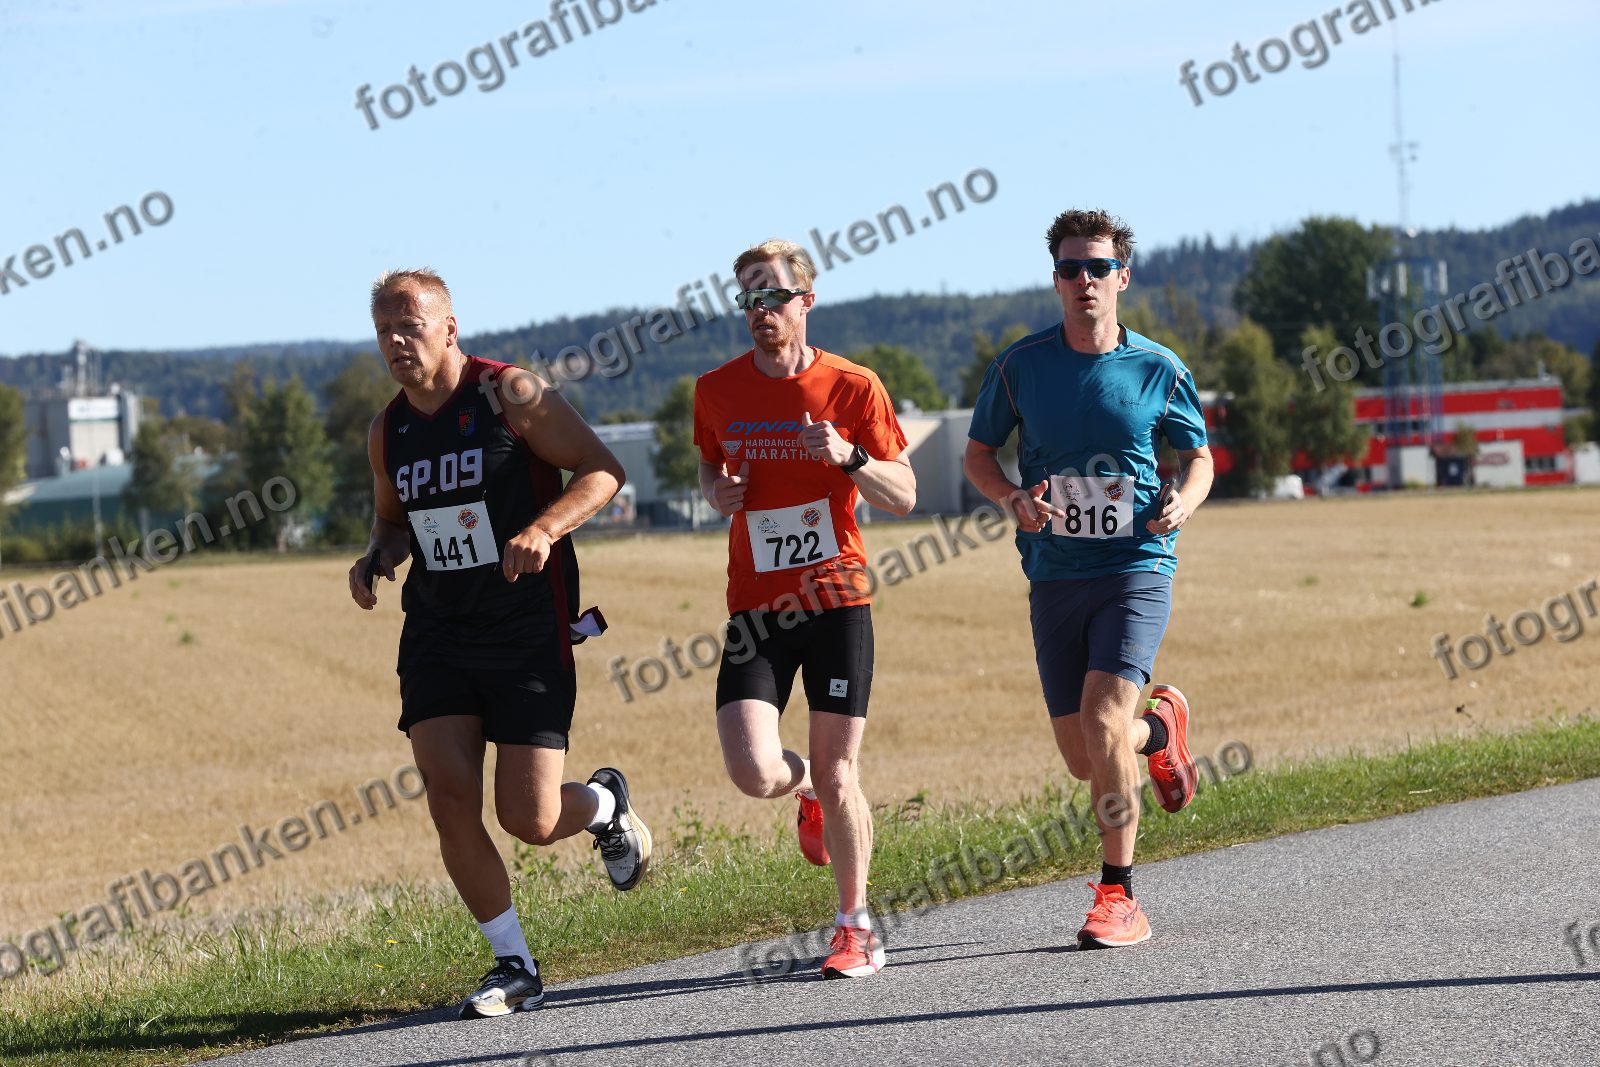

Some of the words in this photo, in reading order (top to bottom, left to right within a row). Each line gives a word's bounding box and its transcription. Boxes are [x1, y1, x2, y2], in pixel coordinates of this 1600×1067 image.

[725, 420, 839, 435] DYNA
[396, 447, 483, 502] SP.09
[1064, 504, 1118, 536] 816
[433, 533, 479, 567] 441
[765, 530, 823, 568] 722
